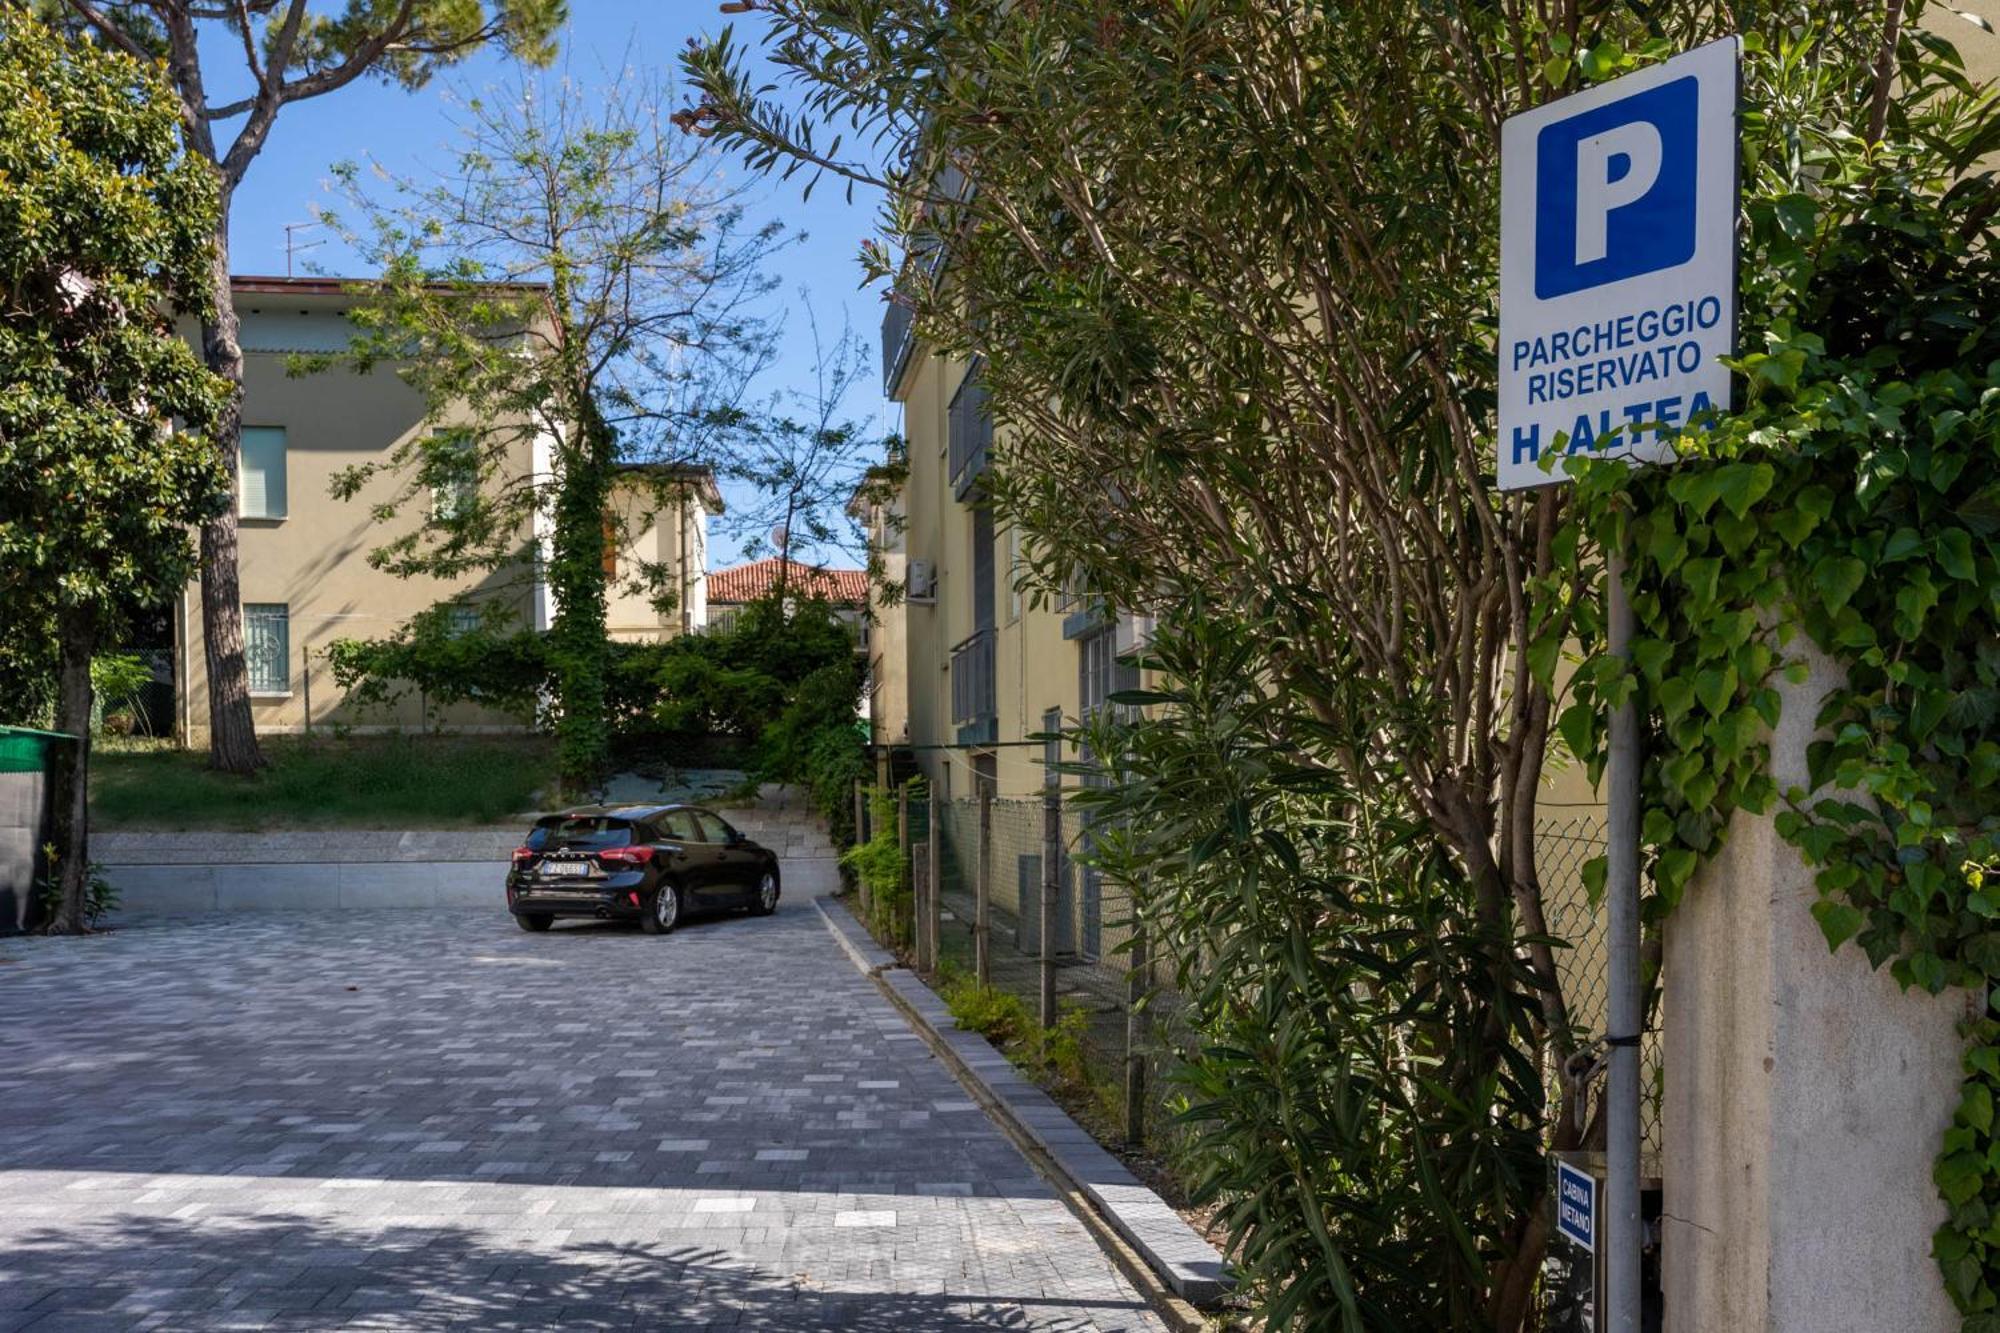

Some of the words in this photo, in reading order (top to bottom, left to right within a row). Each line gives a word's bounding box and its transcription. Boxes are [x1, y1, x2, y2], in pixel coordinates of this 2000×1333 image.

[1575, 120, 1663, 266] P
[1513, 296, 1721, 371] PARCHEGGIO
[1528, 341, 1701, 405] RISERVATO
[1562, 1178, 1589, 1209] CABINA
